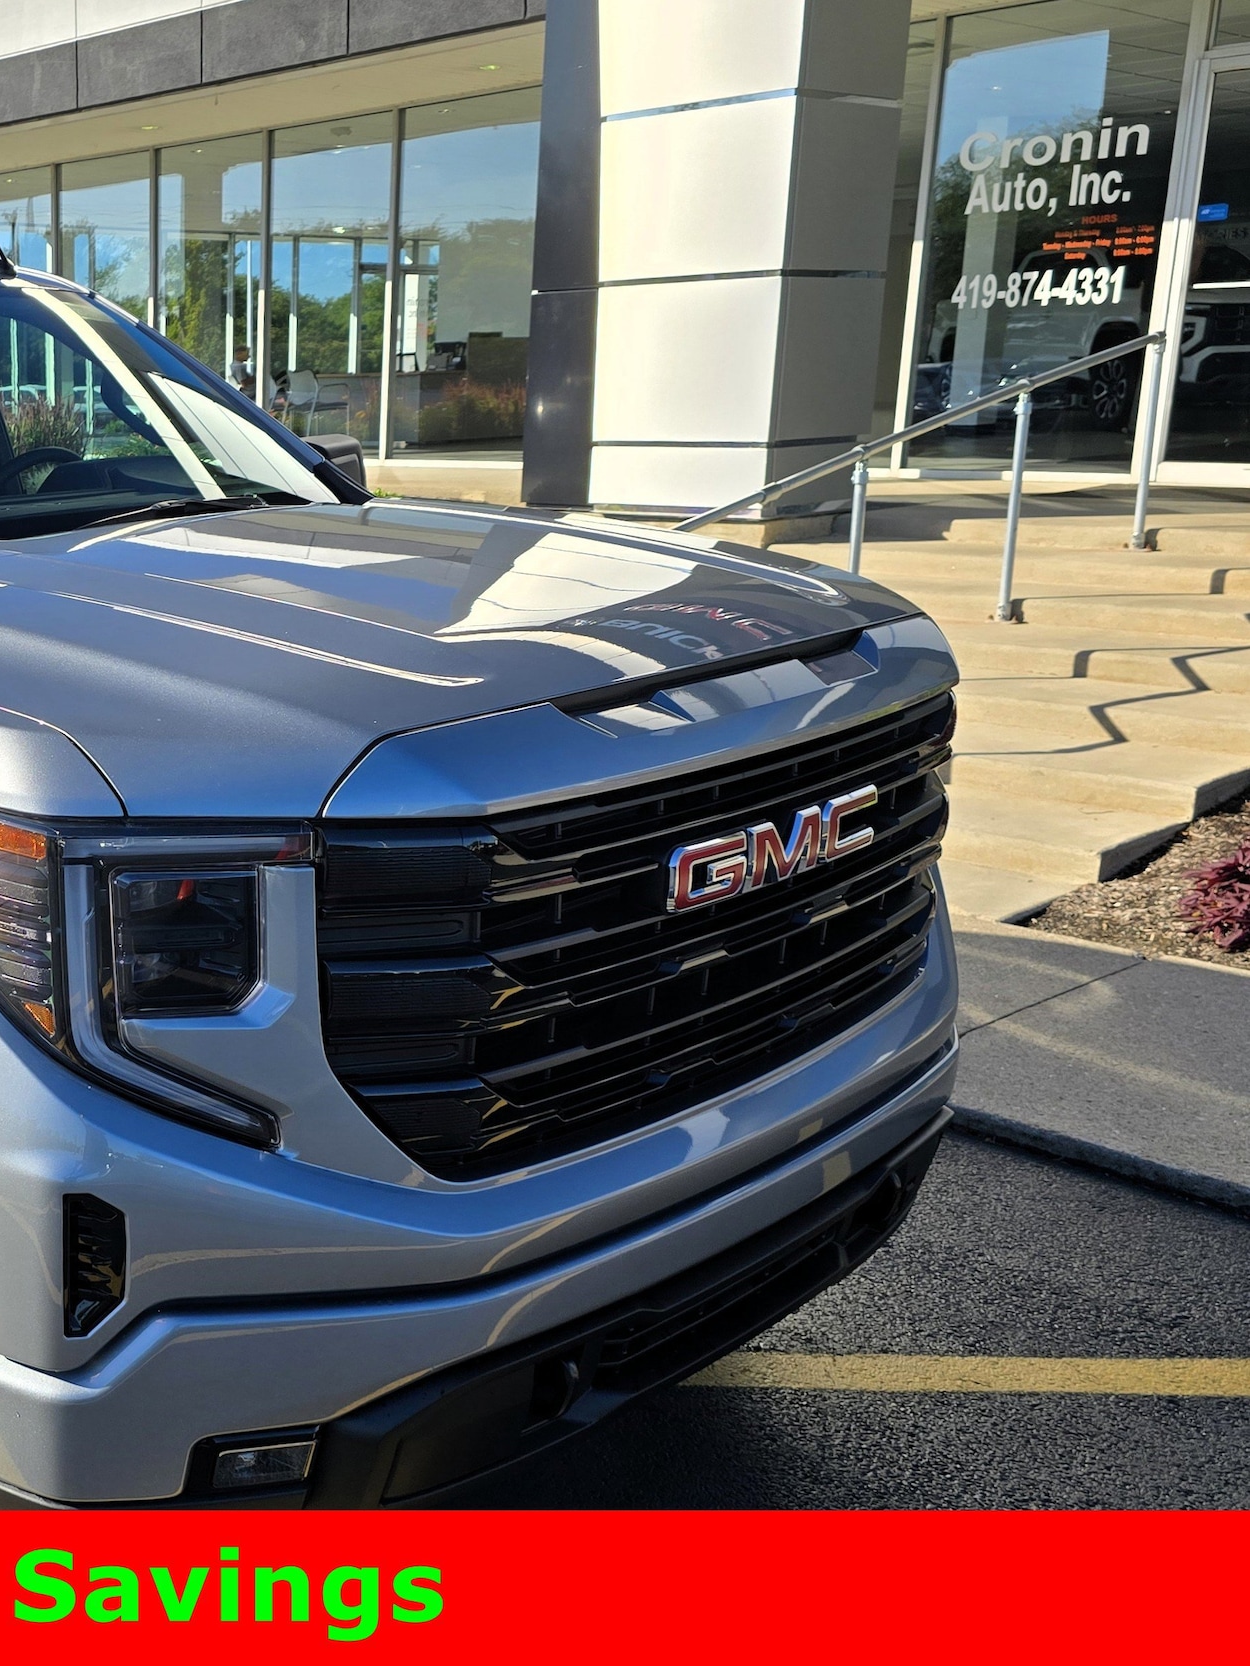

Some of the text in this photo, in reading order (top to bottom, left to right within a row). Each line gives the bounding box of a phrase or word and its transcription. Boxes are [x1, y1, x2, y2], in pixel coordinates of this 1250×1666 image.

[959, 117, 1150, 172] Cronin
[964, 164, 1132, 217] Auto, Inc.
[1081, 213, 1118, 225] HOURS
[951, 265, 1127, 310] 419-874-4331
[666, 784, 878, 913] GMC
